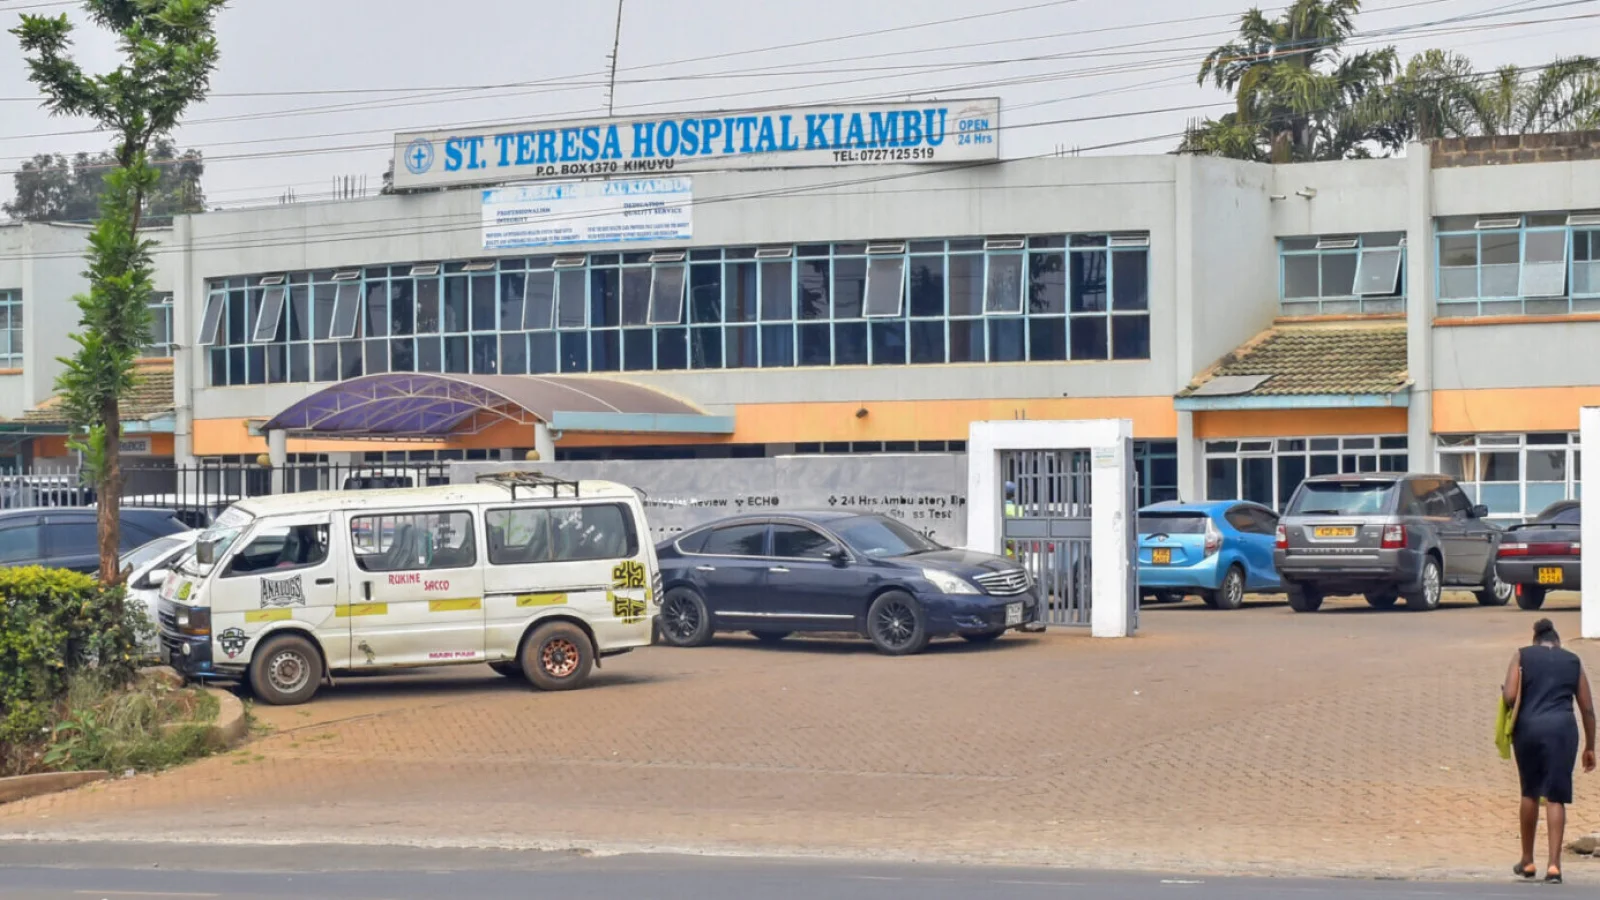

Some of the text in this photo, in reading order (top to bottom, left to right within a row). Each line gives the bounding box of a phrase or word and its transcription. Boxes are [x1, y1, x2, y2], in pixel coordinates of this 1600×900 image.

[958, 119, 989, 131] OPEN
[444, 107, 949, 171] ST. TERESA HOSPITAL KIAMBU
[957, 132, 993, 145] 24 Hrs
[536, 165, 559, 176] P.O.
[624, 158, 675, 172] KIKUYU
[858, 495, 878, 506] Hrs
[928, 508, 952, 519] Test
[388, 572, 421, 585] RUKINE
[261, 575, 303, 600] ANALOGS
[424, 580, 450, 591] SACCO
